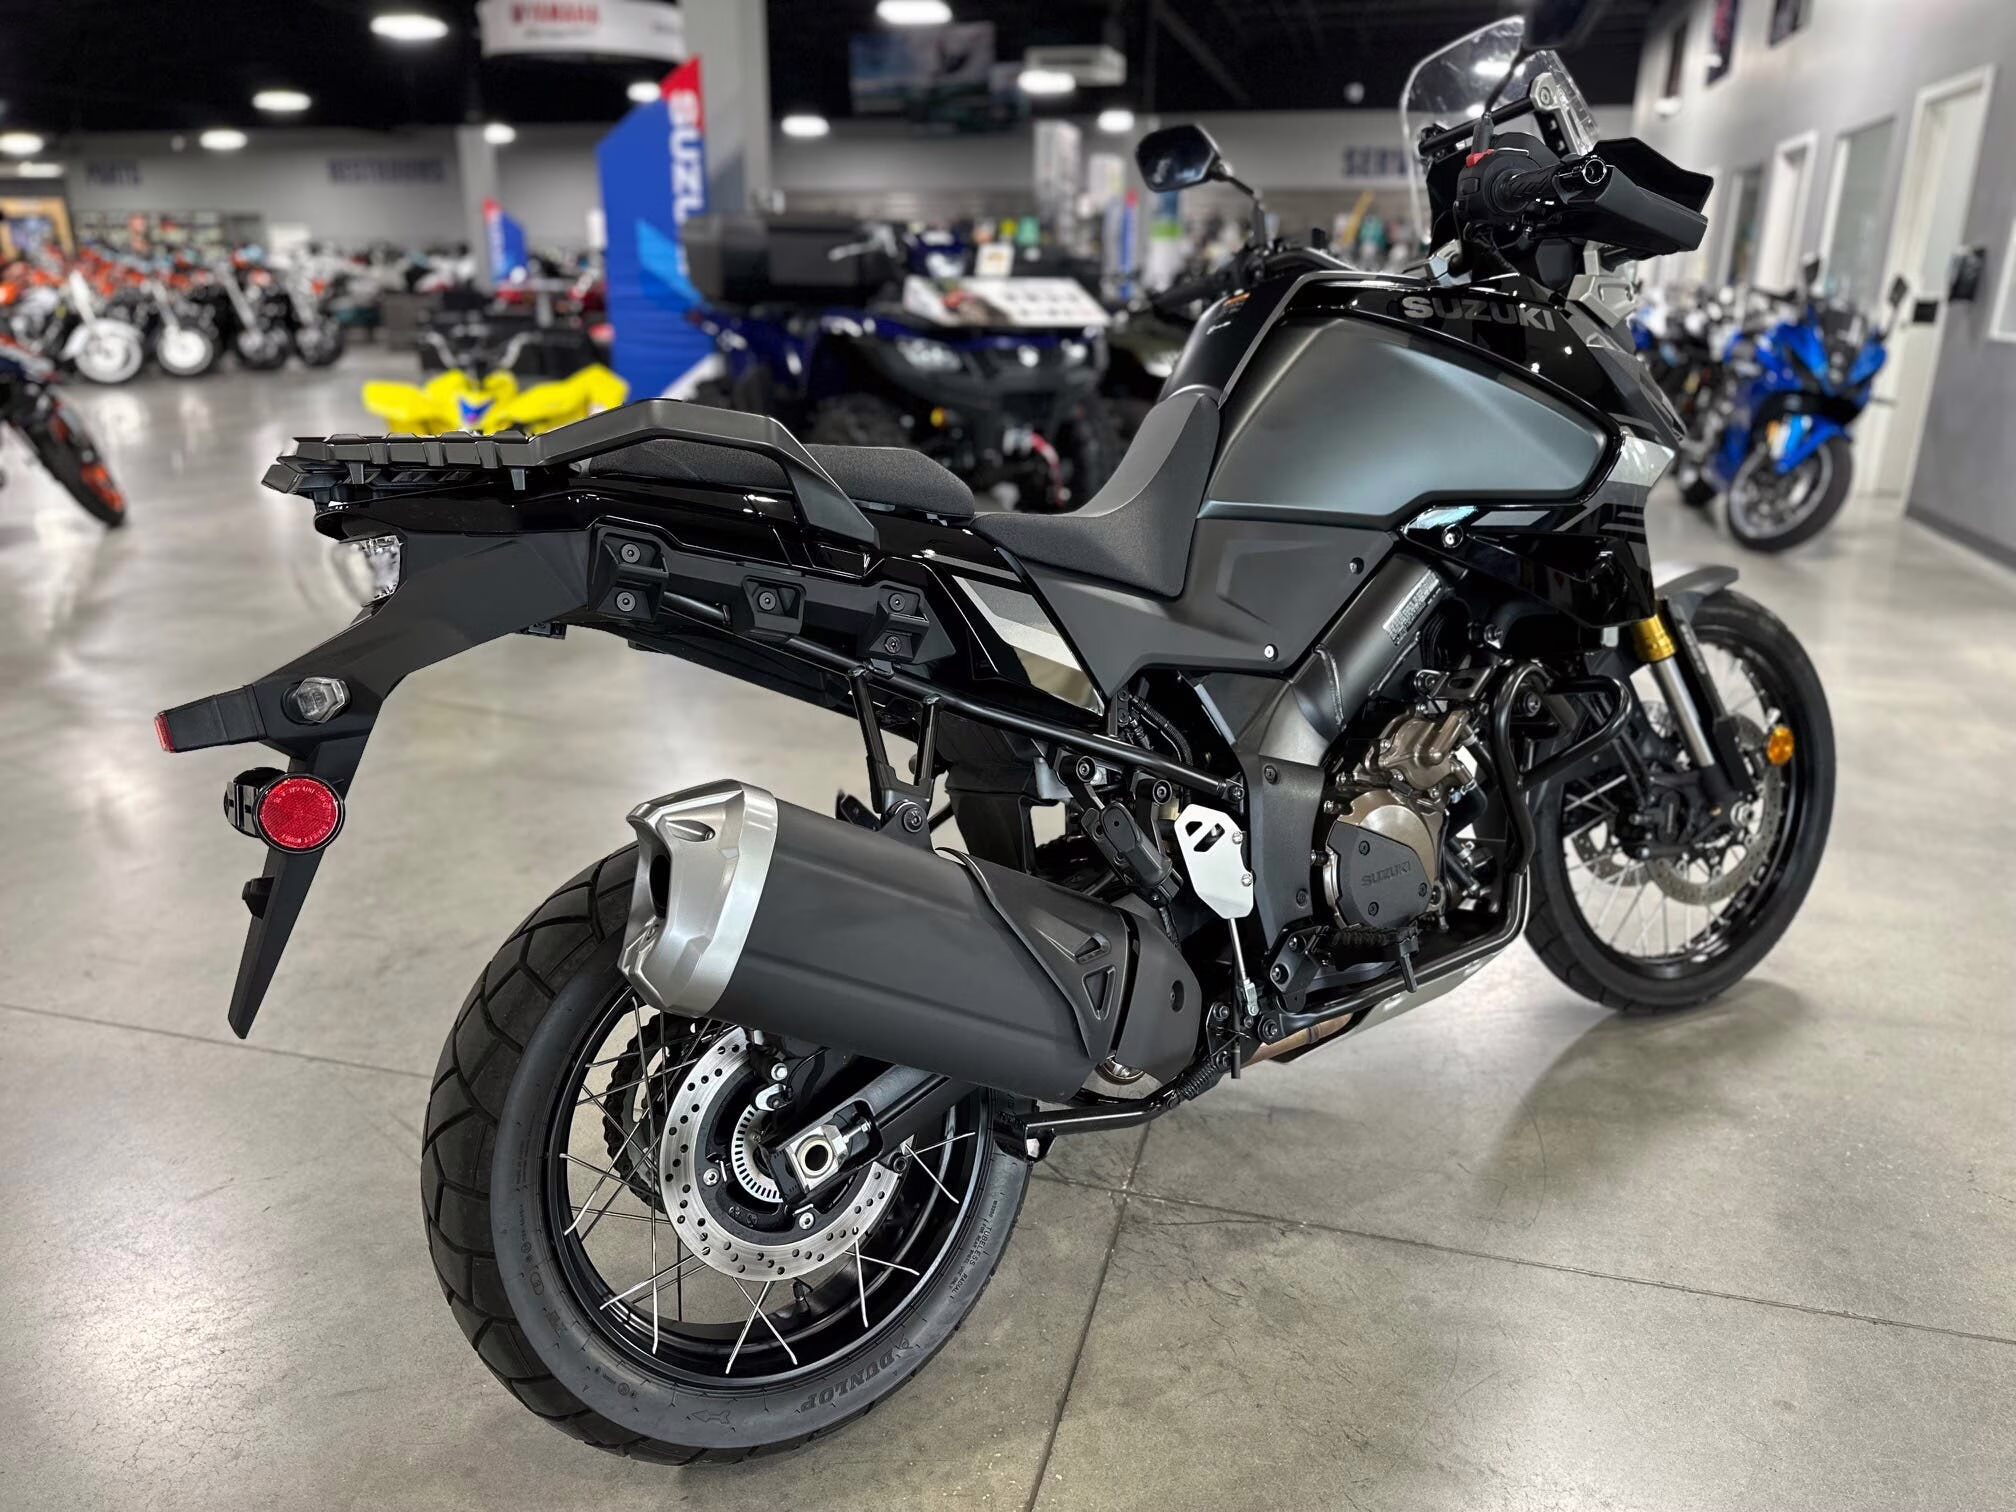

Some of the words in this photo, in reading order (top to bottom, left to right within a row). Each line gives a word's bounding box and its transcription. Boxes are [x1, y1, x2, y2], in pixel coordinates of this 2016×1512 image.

[1402, 296, 1555, 332] SUZUKI
[1361, 861, 1411, 887] SUZUKI
[969, 1226, 992, 1265] TUBELESS
[951, 1272, 968, 1294] RADIAL
[800, 1349, 896, 1412] DUNLOP
